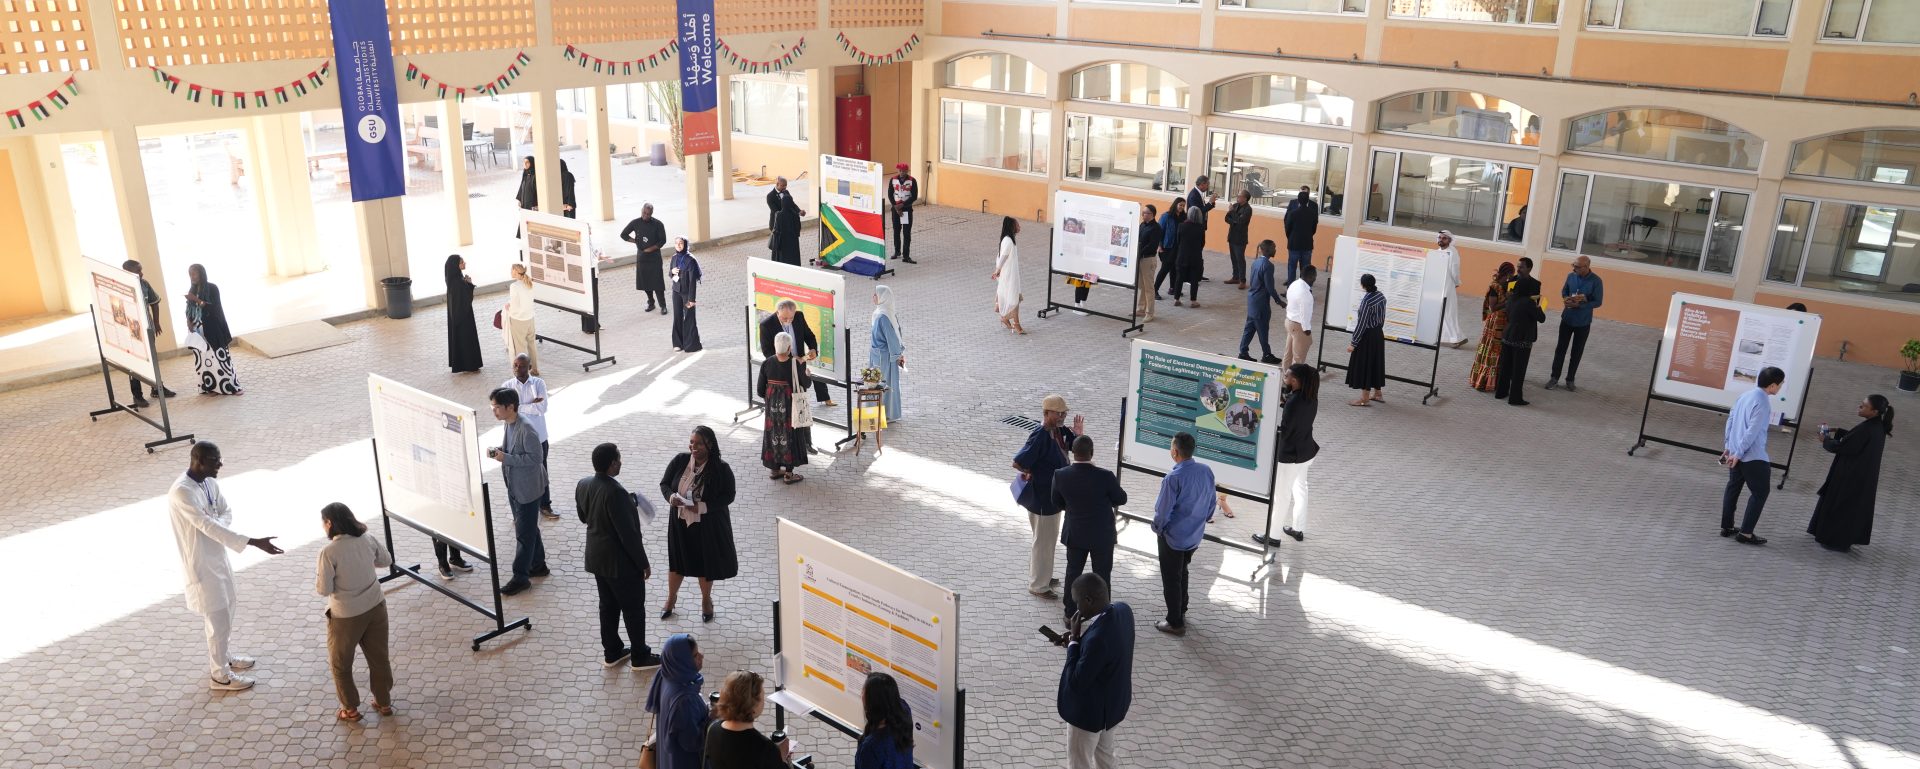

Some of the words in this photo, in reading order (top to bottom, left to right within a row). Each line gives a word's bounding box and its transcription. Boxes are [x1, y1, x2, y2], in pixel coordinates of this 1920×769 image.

[359, 40, 369, 72] STUDIES
[701, 13, 713, 85] Welcome
[357, 82, 366, 111] GLOBAL
[371, 67, 382, 111] UNIVERSITY
[368, 119, 377, 139] GSU
[1148, 361, 1171, 372] Fostering
[1213, 373, 1226, 381] Case
[1233, 379, 1257, 387] Tanzania
[1155, 355, 1165, 363] Role
[1173, 359, 1195, 368] Electoral
[1196, 363, 1224, 376] Democracy
[1237, 372, 1256, 381] Protest
